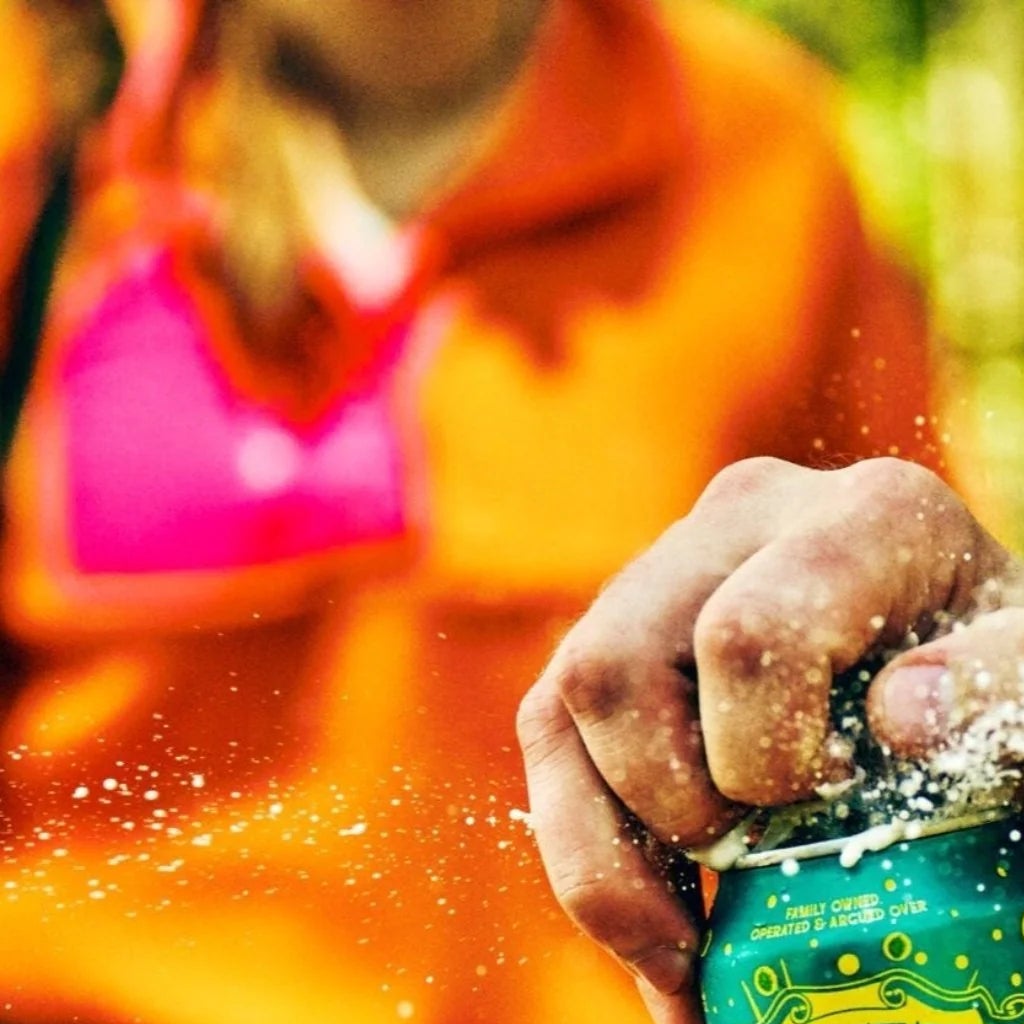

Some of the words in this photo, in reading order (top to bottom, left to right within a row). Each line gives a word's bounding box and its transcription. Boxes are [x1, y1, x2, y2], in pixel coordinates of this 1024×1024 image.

[750, 920, 810, 940] OPERATED
[814, 918, 827, 931] &
[830, 908, 885, 929] ARGUED
[889, 900, 927, 917] OVER
[785, 902, 826, 920] FAMILY
[831, 893, 879, 912] OWNED
